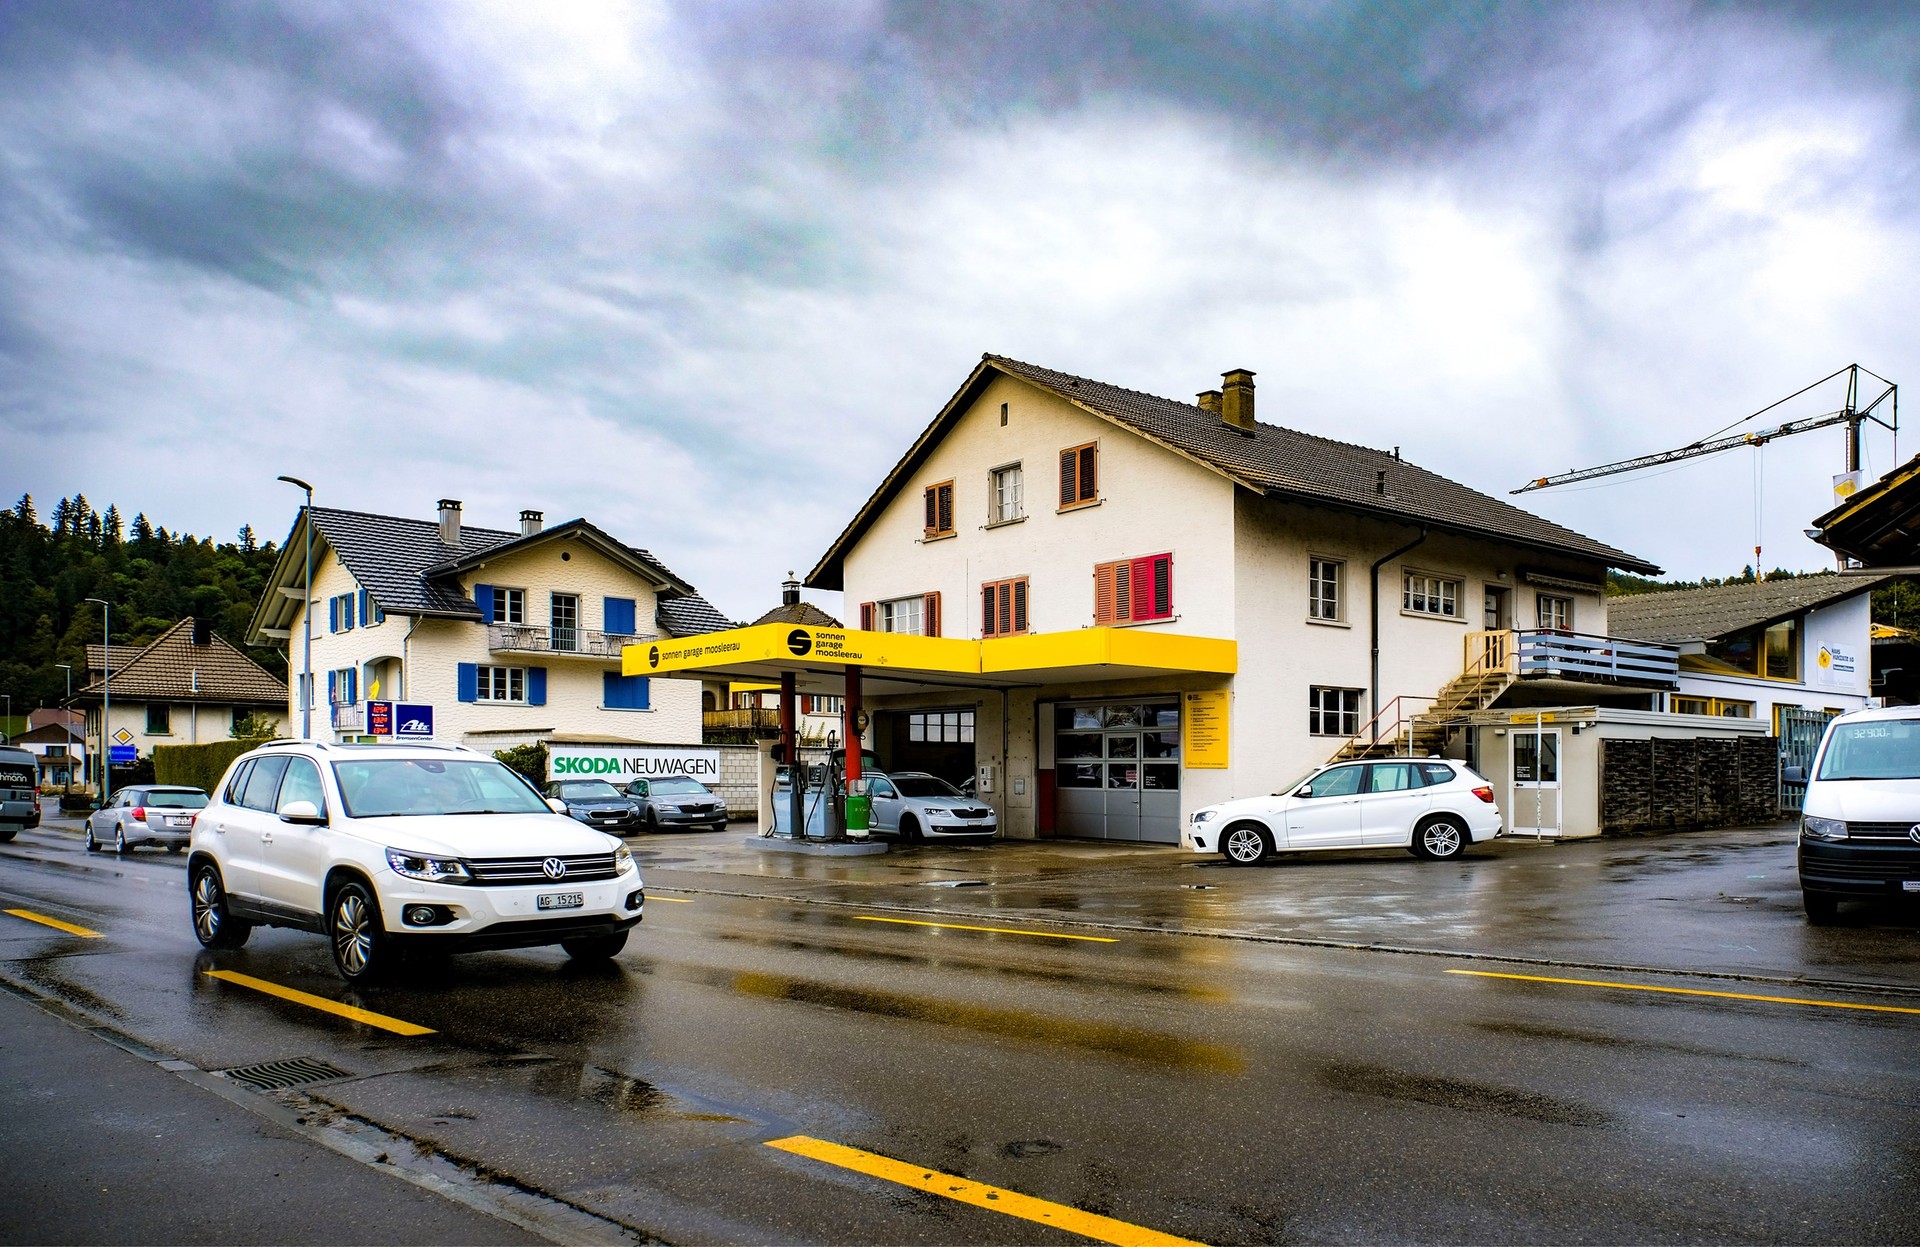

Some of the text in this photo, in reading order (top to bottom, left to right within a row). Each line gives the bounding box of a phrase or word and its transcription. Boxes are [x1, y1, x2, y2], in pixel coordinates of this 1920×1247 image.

[816, 631, 845, 641] sonnen
[662, 641, 741, 660] sonnen garage moosleerau
[816, 641, 843, 650] garage
[816, 649, 863, 659] moosleerau
[554, 757, 716, 775] SKODA NEUWAGEN
[540, 894, 583, 906] AG 15215
